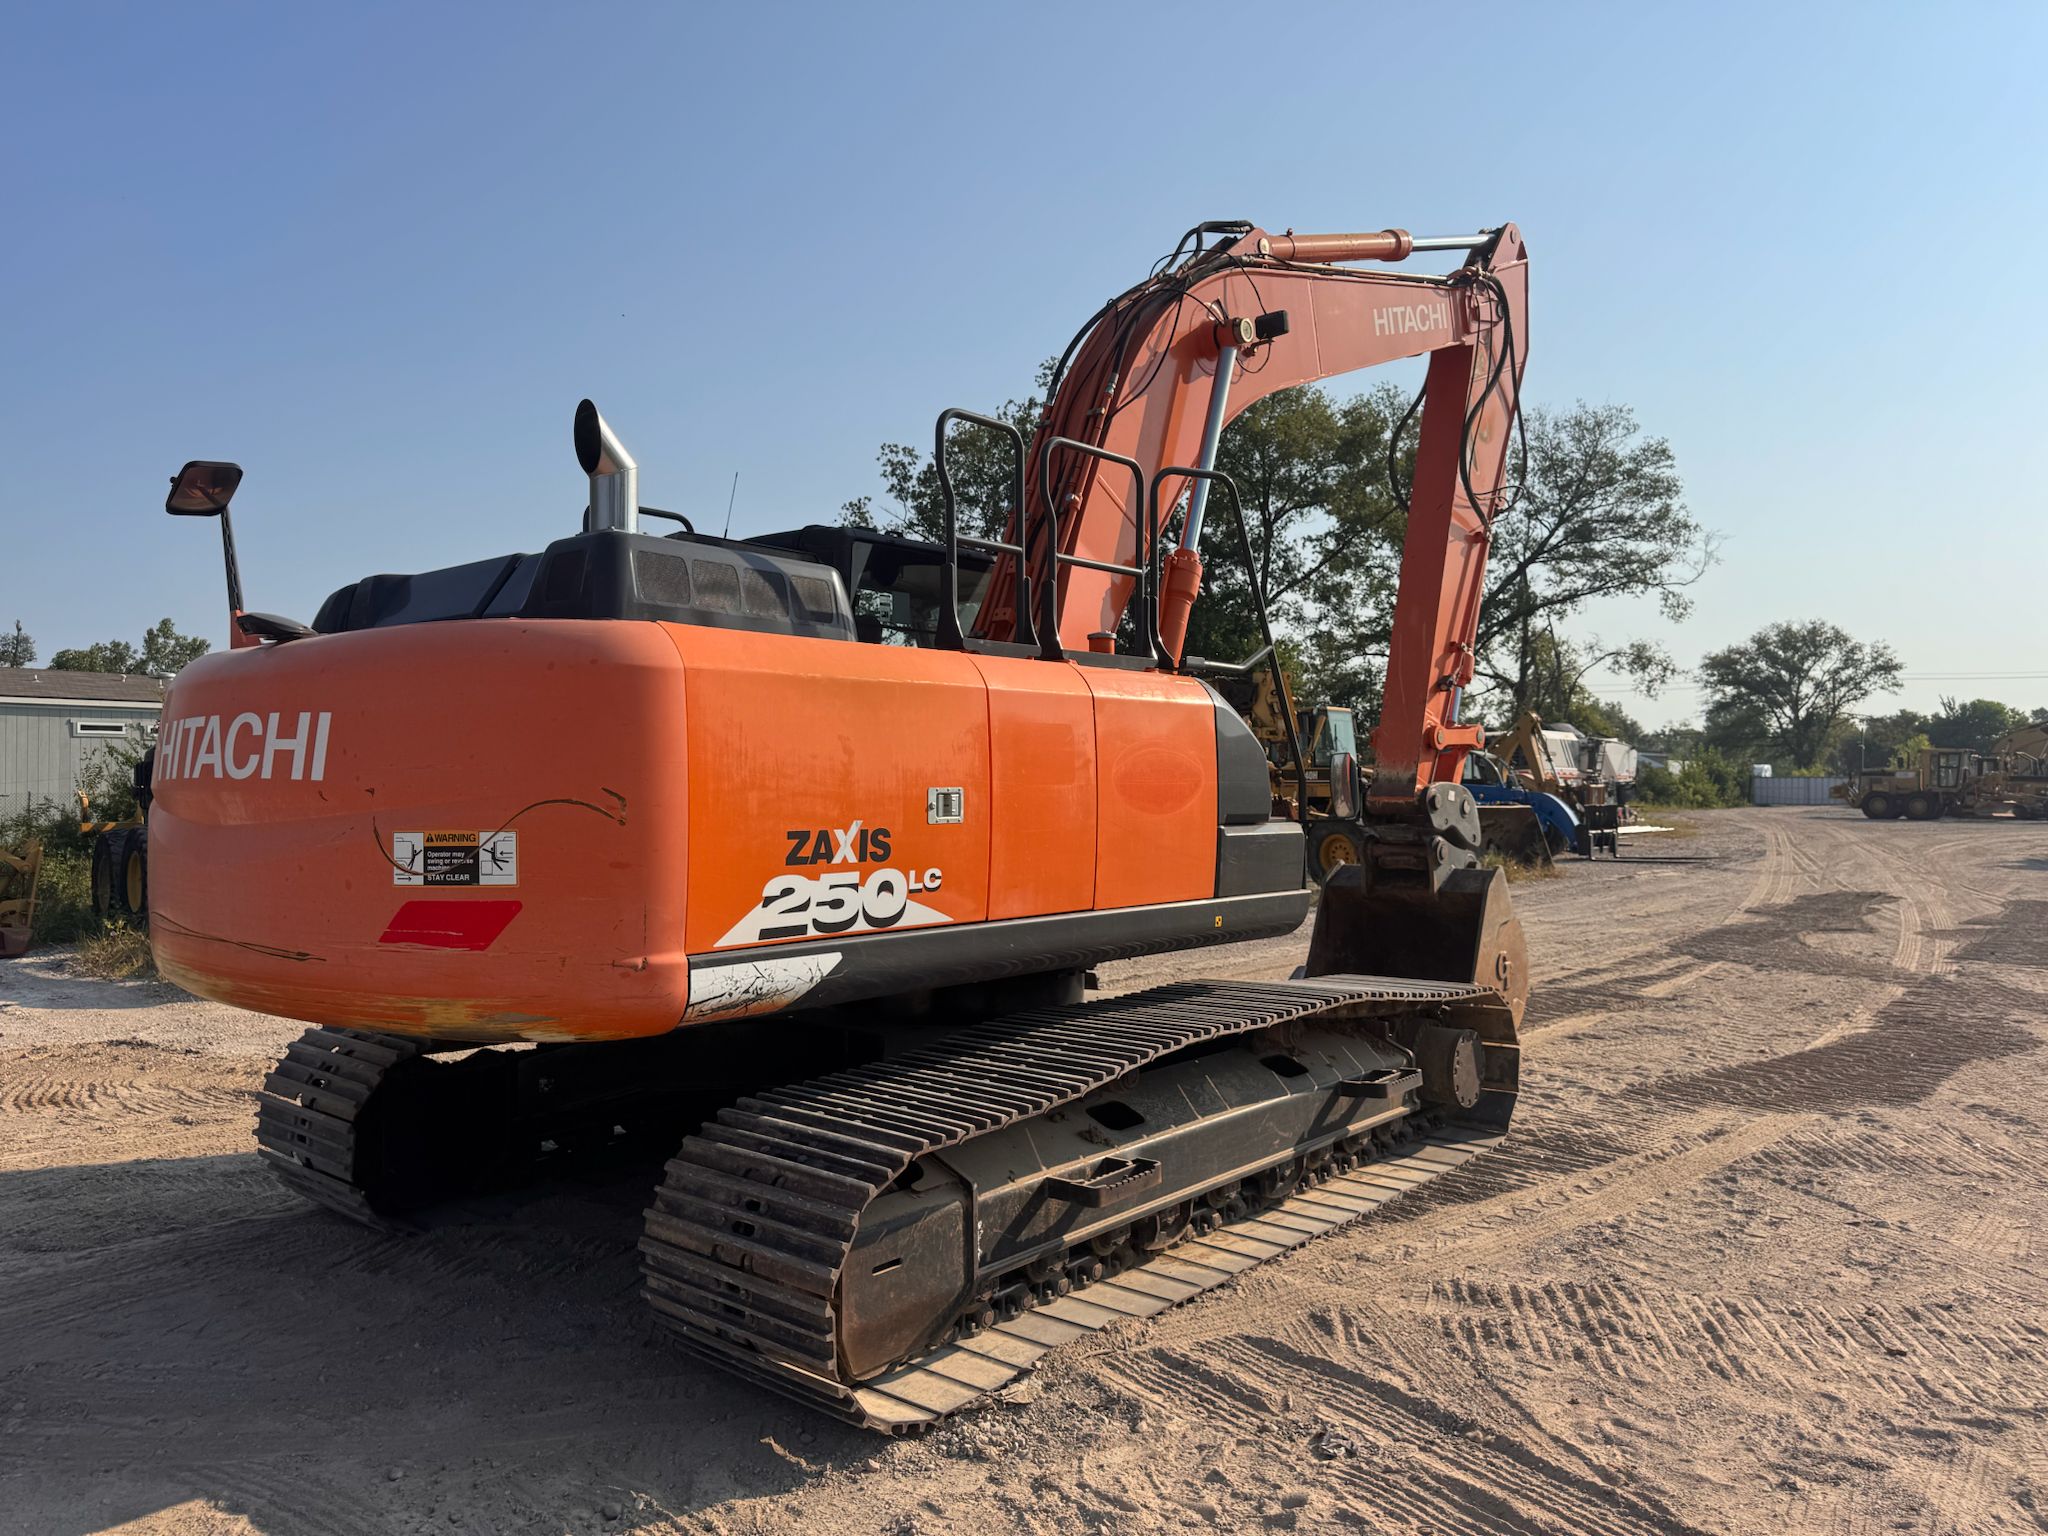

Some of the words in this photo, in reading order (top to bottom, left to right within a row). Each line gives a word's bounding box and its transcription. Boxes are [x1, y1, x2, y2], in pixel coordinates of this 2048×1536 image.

[1373, 303, 1448, 336] HITACHI
[158, 711, 332, 781] HITACHI
[434, 833, 477, 843] WARNING
[785, 820, 892, 866] ZAXIS
